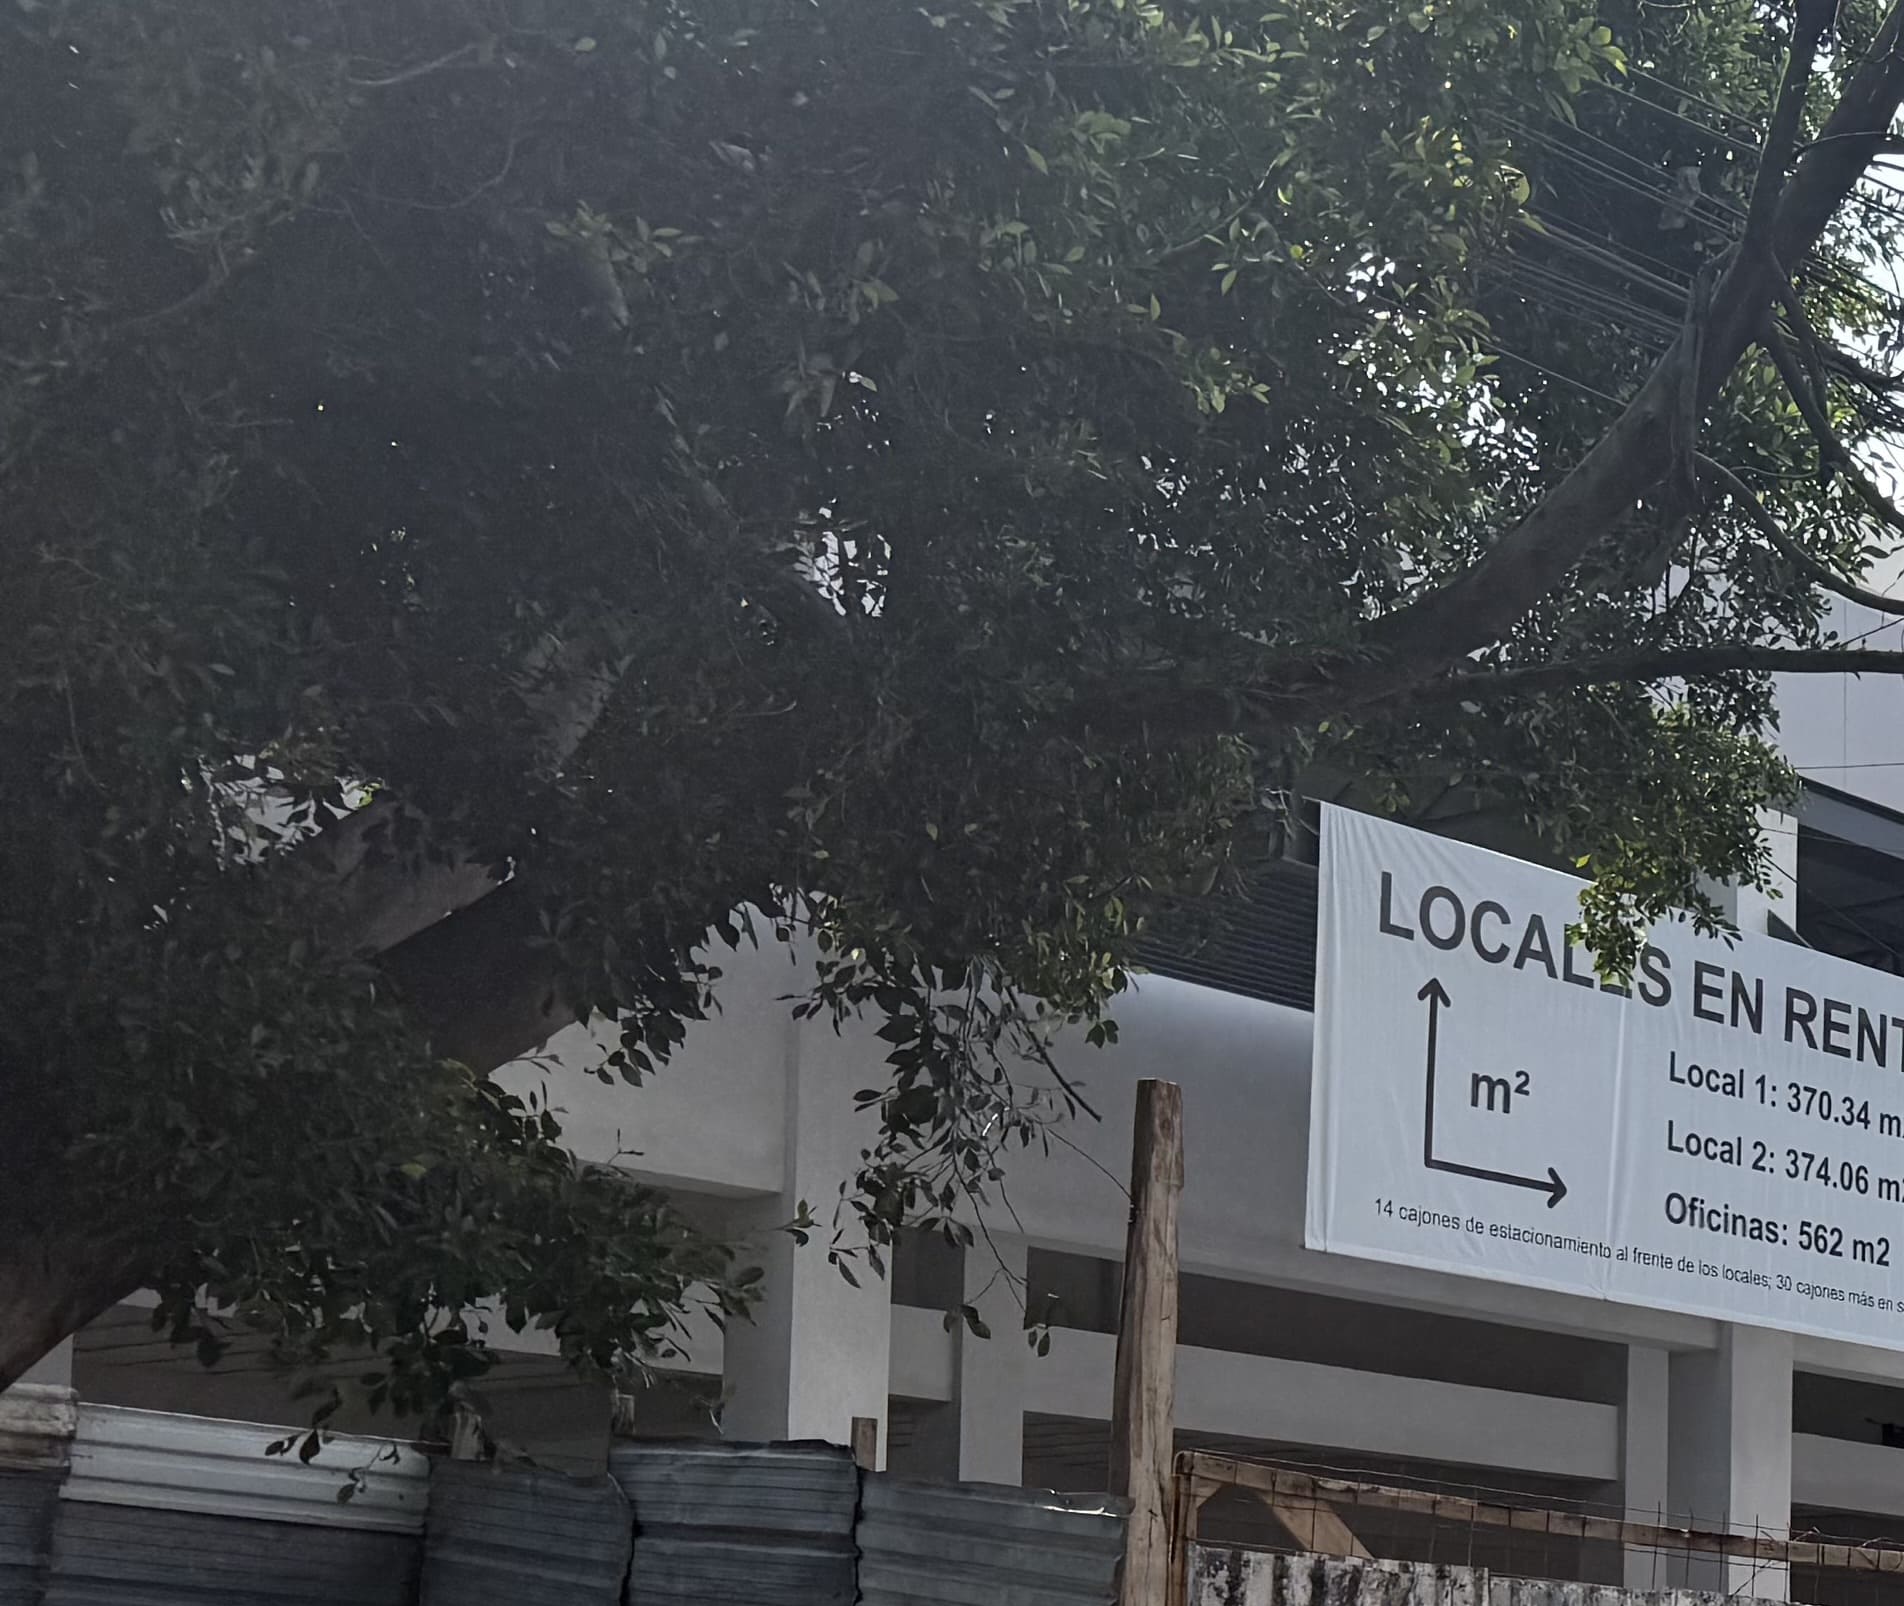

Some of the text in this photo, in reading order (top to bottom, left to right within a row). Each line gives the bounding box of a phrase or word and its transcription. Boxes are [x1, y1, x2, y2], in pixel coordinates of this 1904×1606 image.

[1379, 871, 1672, 1007] LOCALS
[1693, 959, 1764, 1035] EN
[1669, 1050, 1744, 1099] Local
[1755, 1075, 1778, 1107] 1:
[1787, 1082, 1871, 1131] 370.34
[1667, 1119, 1742, 1167] Local
[1751, 1141, 1775, 1174] 2:
[1785, 1148, 1869, 1195] 374.06
[1375, 1198, 1393, 1218] 14
[1399, 1204, 1460, 1230] cajones
[1465, 1216, 1484, 1235] de
[1489, 1223, 1612, 1259] estacionamiento
[1615, 1246, 1628, 1262] al
[1632, 1247, 1673, 1270] frente
[1677, 1256, 1694, 1274] de
[1698, 1260, 1718, 1278] los
[1776, 1274, 1793, 1291] 30
[1796, 1280, 1845, 1302] cajones
[1877, 1297, 1894, 1312] en
[1665, 1192, 1890, 1267] Oficinas: 562 m2
